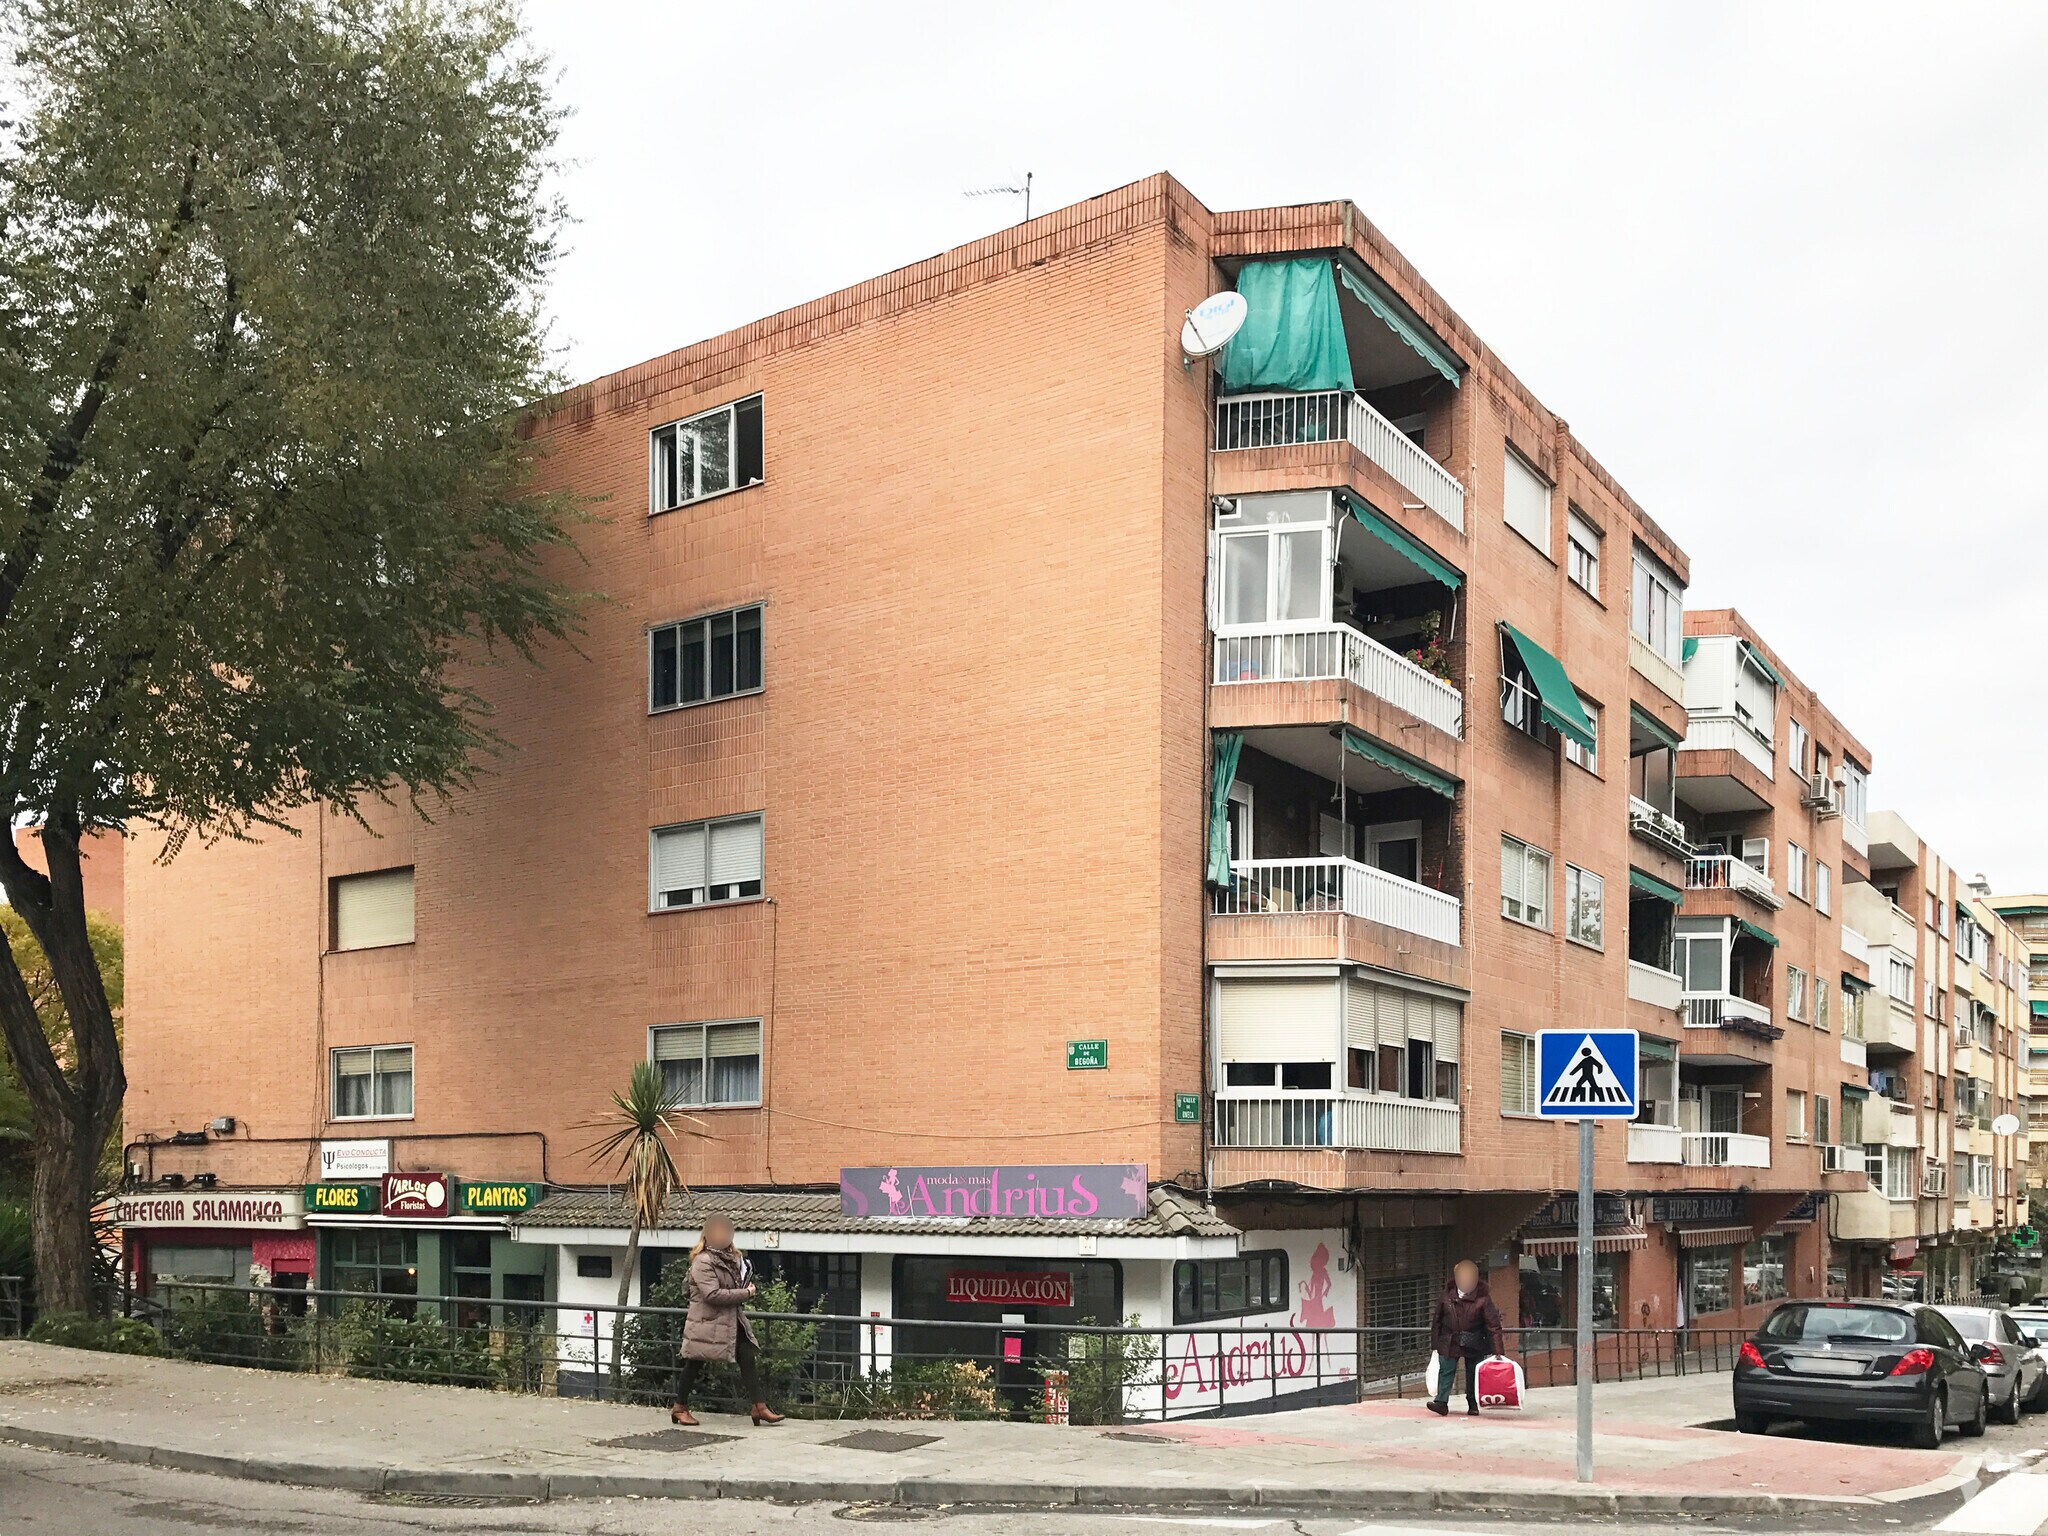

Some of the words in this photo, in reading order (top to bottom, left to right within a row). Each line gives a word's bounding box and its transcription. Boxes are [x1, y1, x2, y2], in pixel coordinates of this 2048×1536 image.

[1074, 1056, 1098, 1065] BEGOÑA
[316, 1188, 358, 1207] FLORES
[401, 1201, 425, 1210] Floristas
[468, 1187, 527, 1207] PLANTAS
[116, 1202, 184, 1221] CAFETERIA
[193, 1200, 282, 1222] SALAMANCA
[1669, 1200, 1699, 1219] HIPER
[1703, 1199, 1733, 1218] BAZAR
[949, 1275, 1067, 1301] LIQUIDACIÓN
